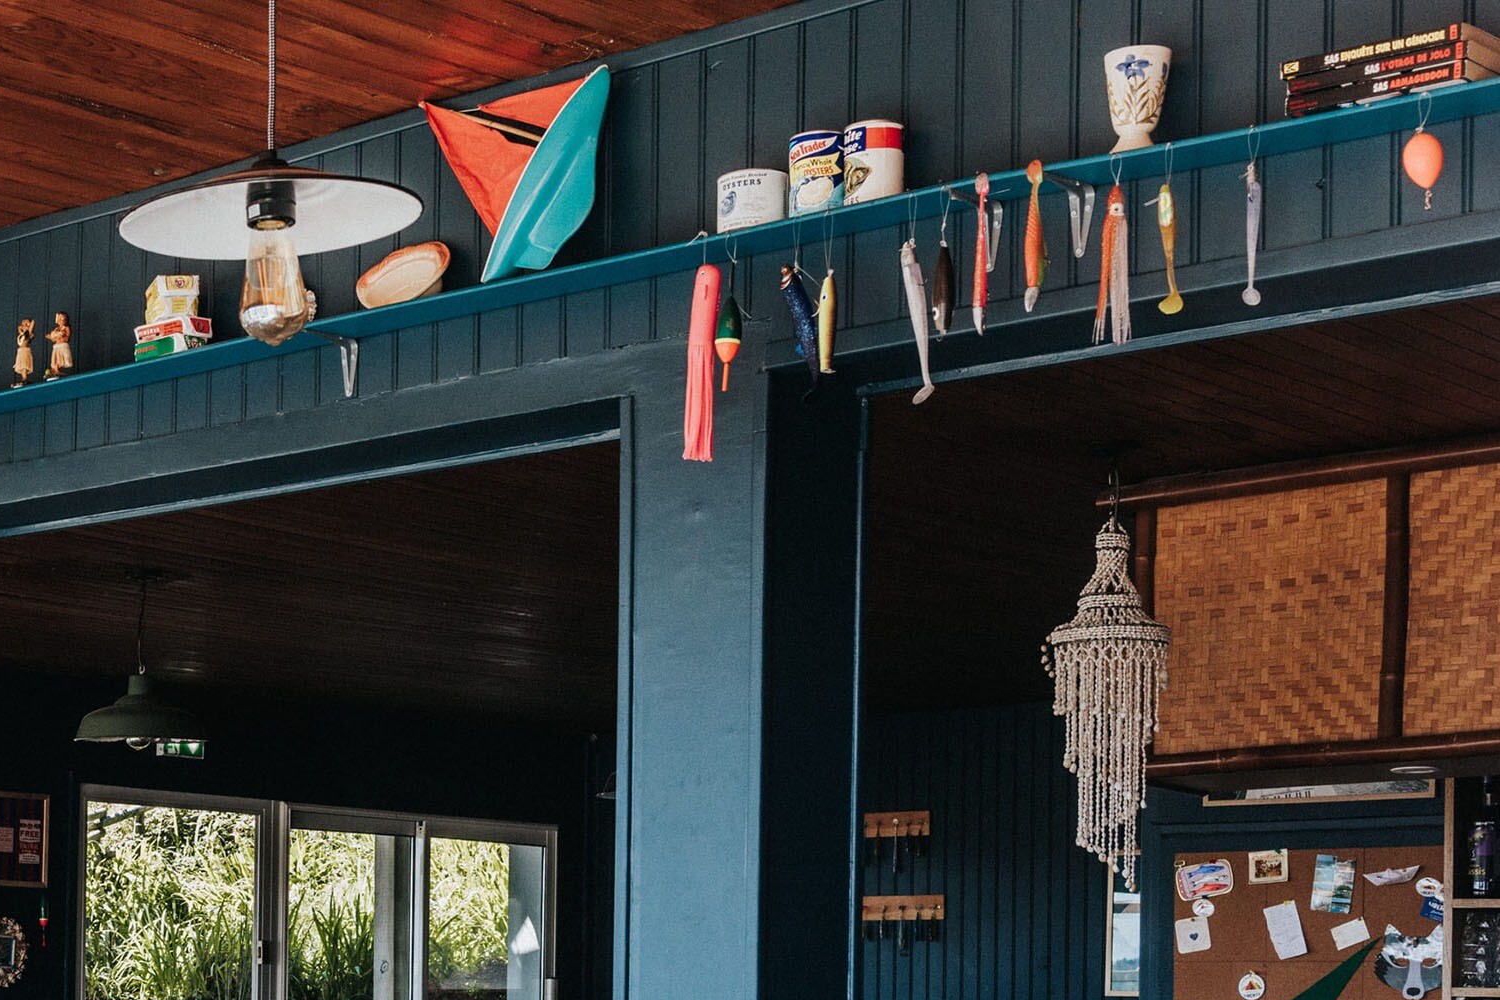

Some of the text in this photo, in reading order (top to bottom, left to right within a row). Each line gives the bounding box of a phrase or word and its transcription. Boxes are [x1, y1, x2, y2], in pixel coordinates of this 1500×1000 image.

[1323, 53, 1339, 65] SAS
[1340, 45, 1374, 62] ENQUÊTE
[1375, 42, 1391, 54] SUR
[1392, 38, 1404, 50] UN
[1405, 30, 1446, 47] GÉNOCIDE
[1364, 63, 1380, 75] SAS
[1381, 55, 1415, 71] L'OTAGE
[1416, 53, 1428, 64] DE
[1429, 48, 1451, 61] JOLO
[1372, 81, 1389, 93] SAS
[1389, 68, 1450, 89] ARMAGEDDON
[799, 139, 828, 155] Trader
[803, 166, 834, 176] OYSTERS
[723, 178, 762, 191] OYSTERS
